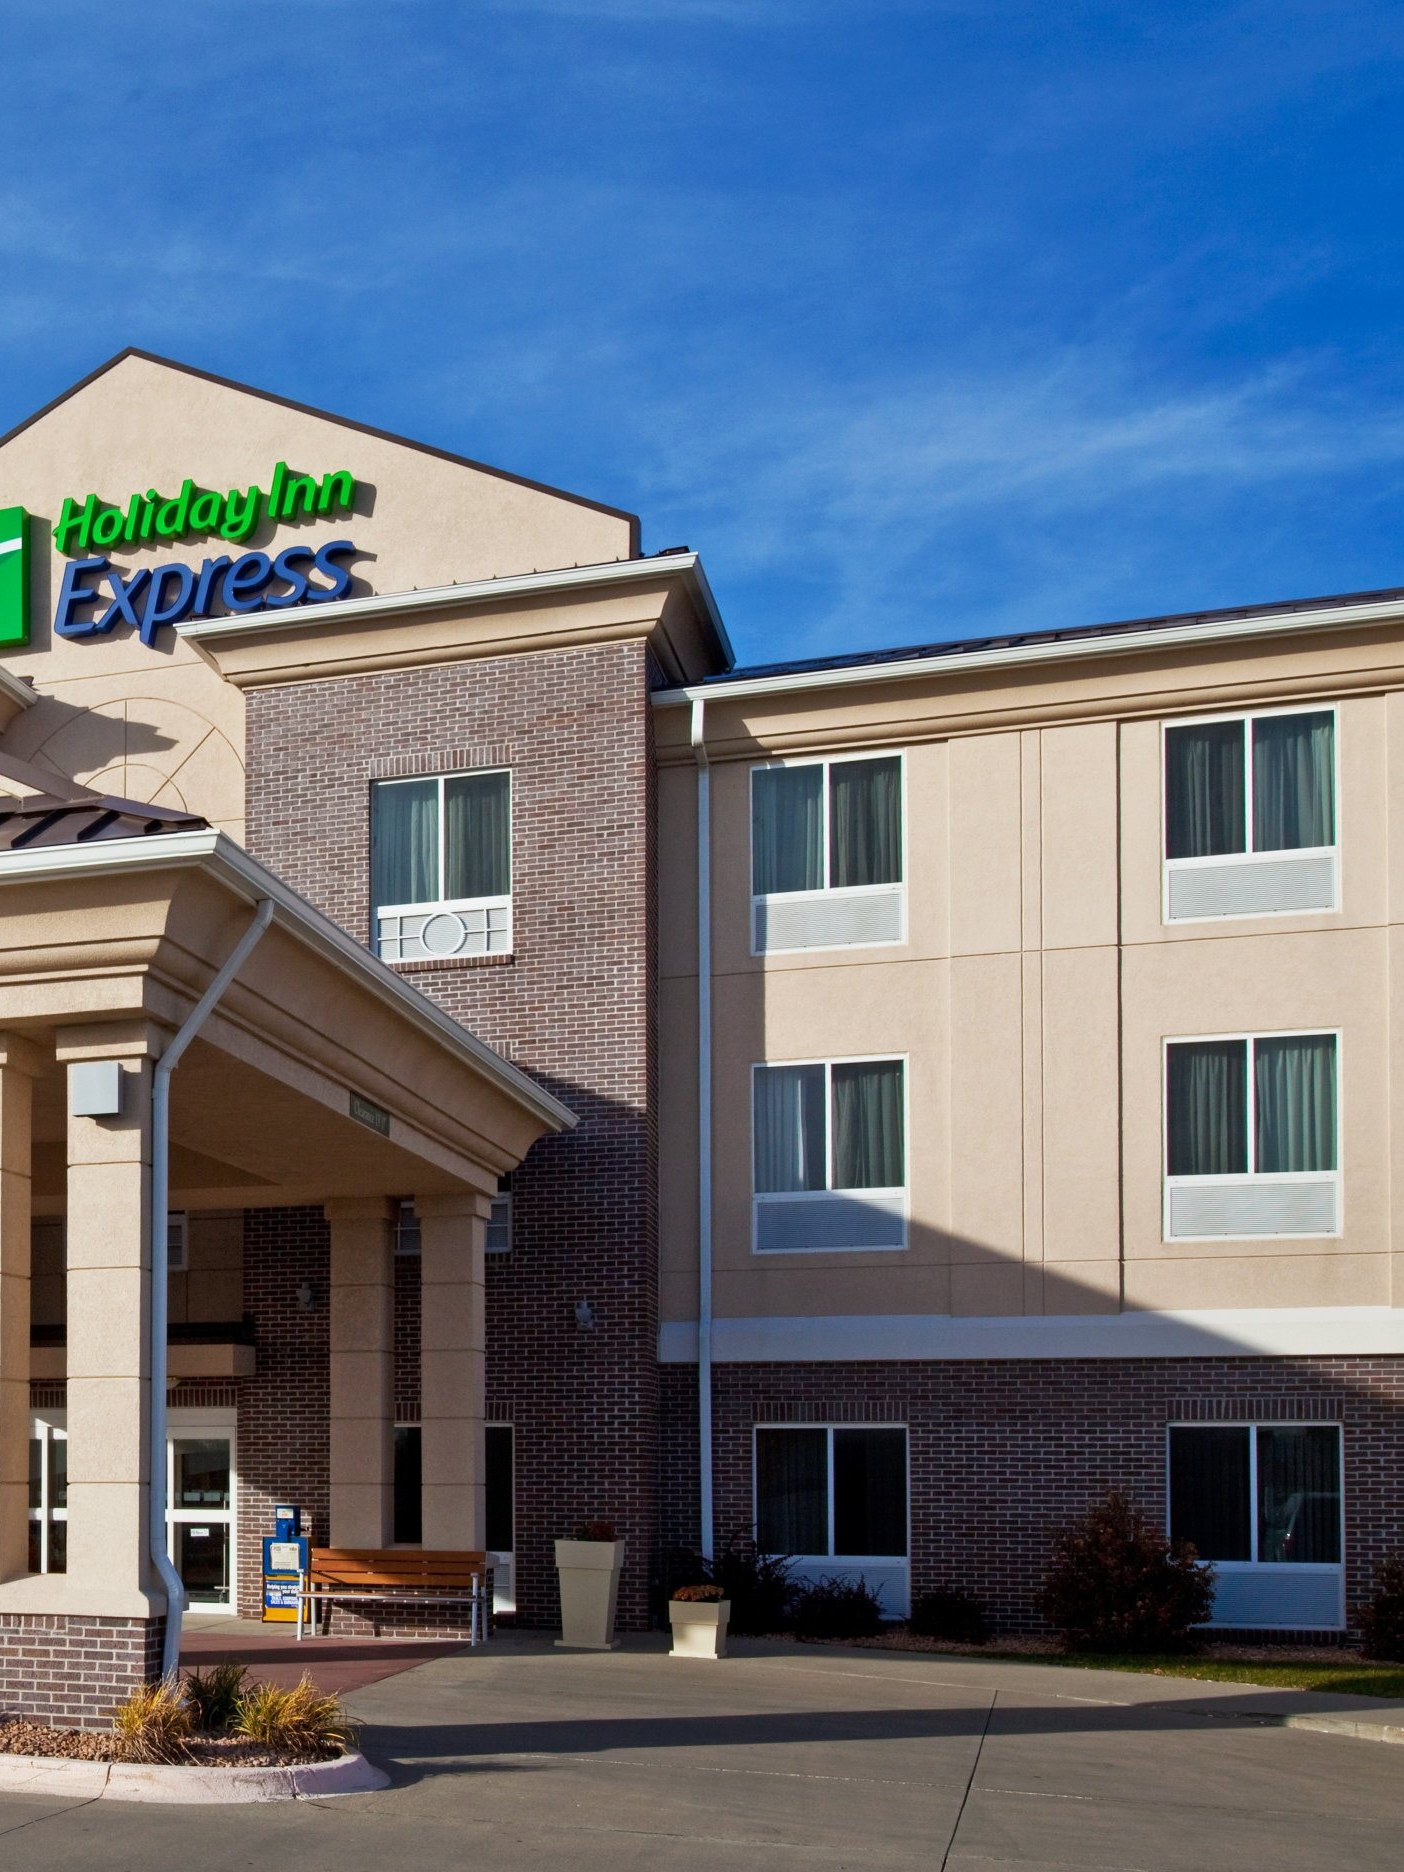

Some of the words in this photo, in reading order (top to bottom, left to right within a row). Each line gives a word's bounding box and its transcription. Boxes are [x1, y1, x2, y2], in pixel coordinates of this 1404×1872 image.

[52, 478, 262, 555] Holiday
[267, 461, 355, 522] Inn
[53, 540, 357, 648] Express
